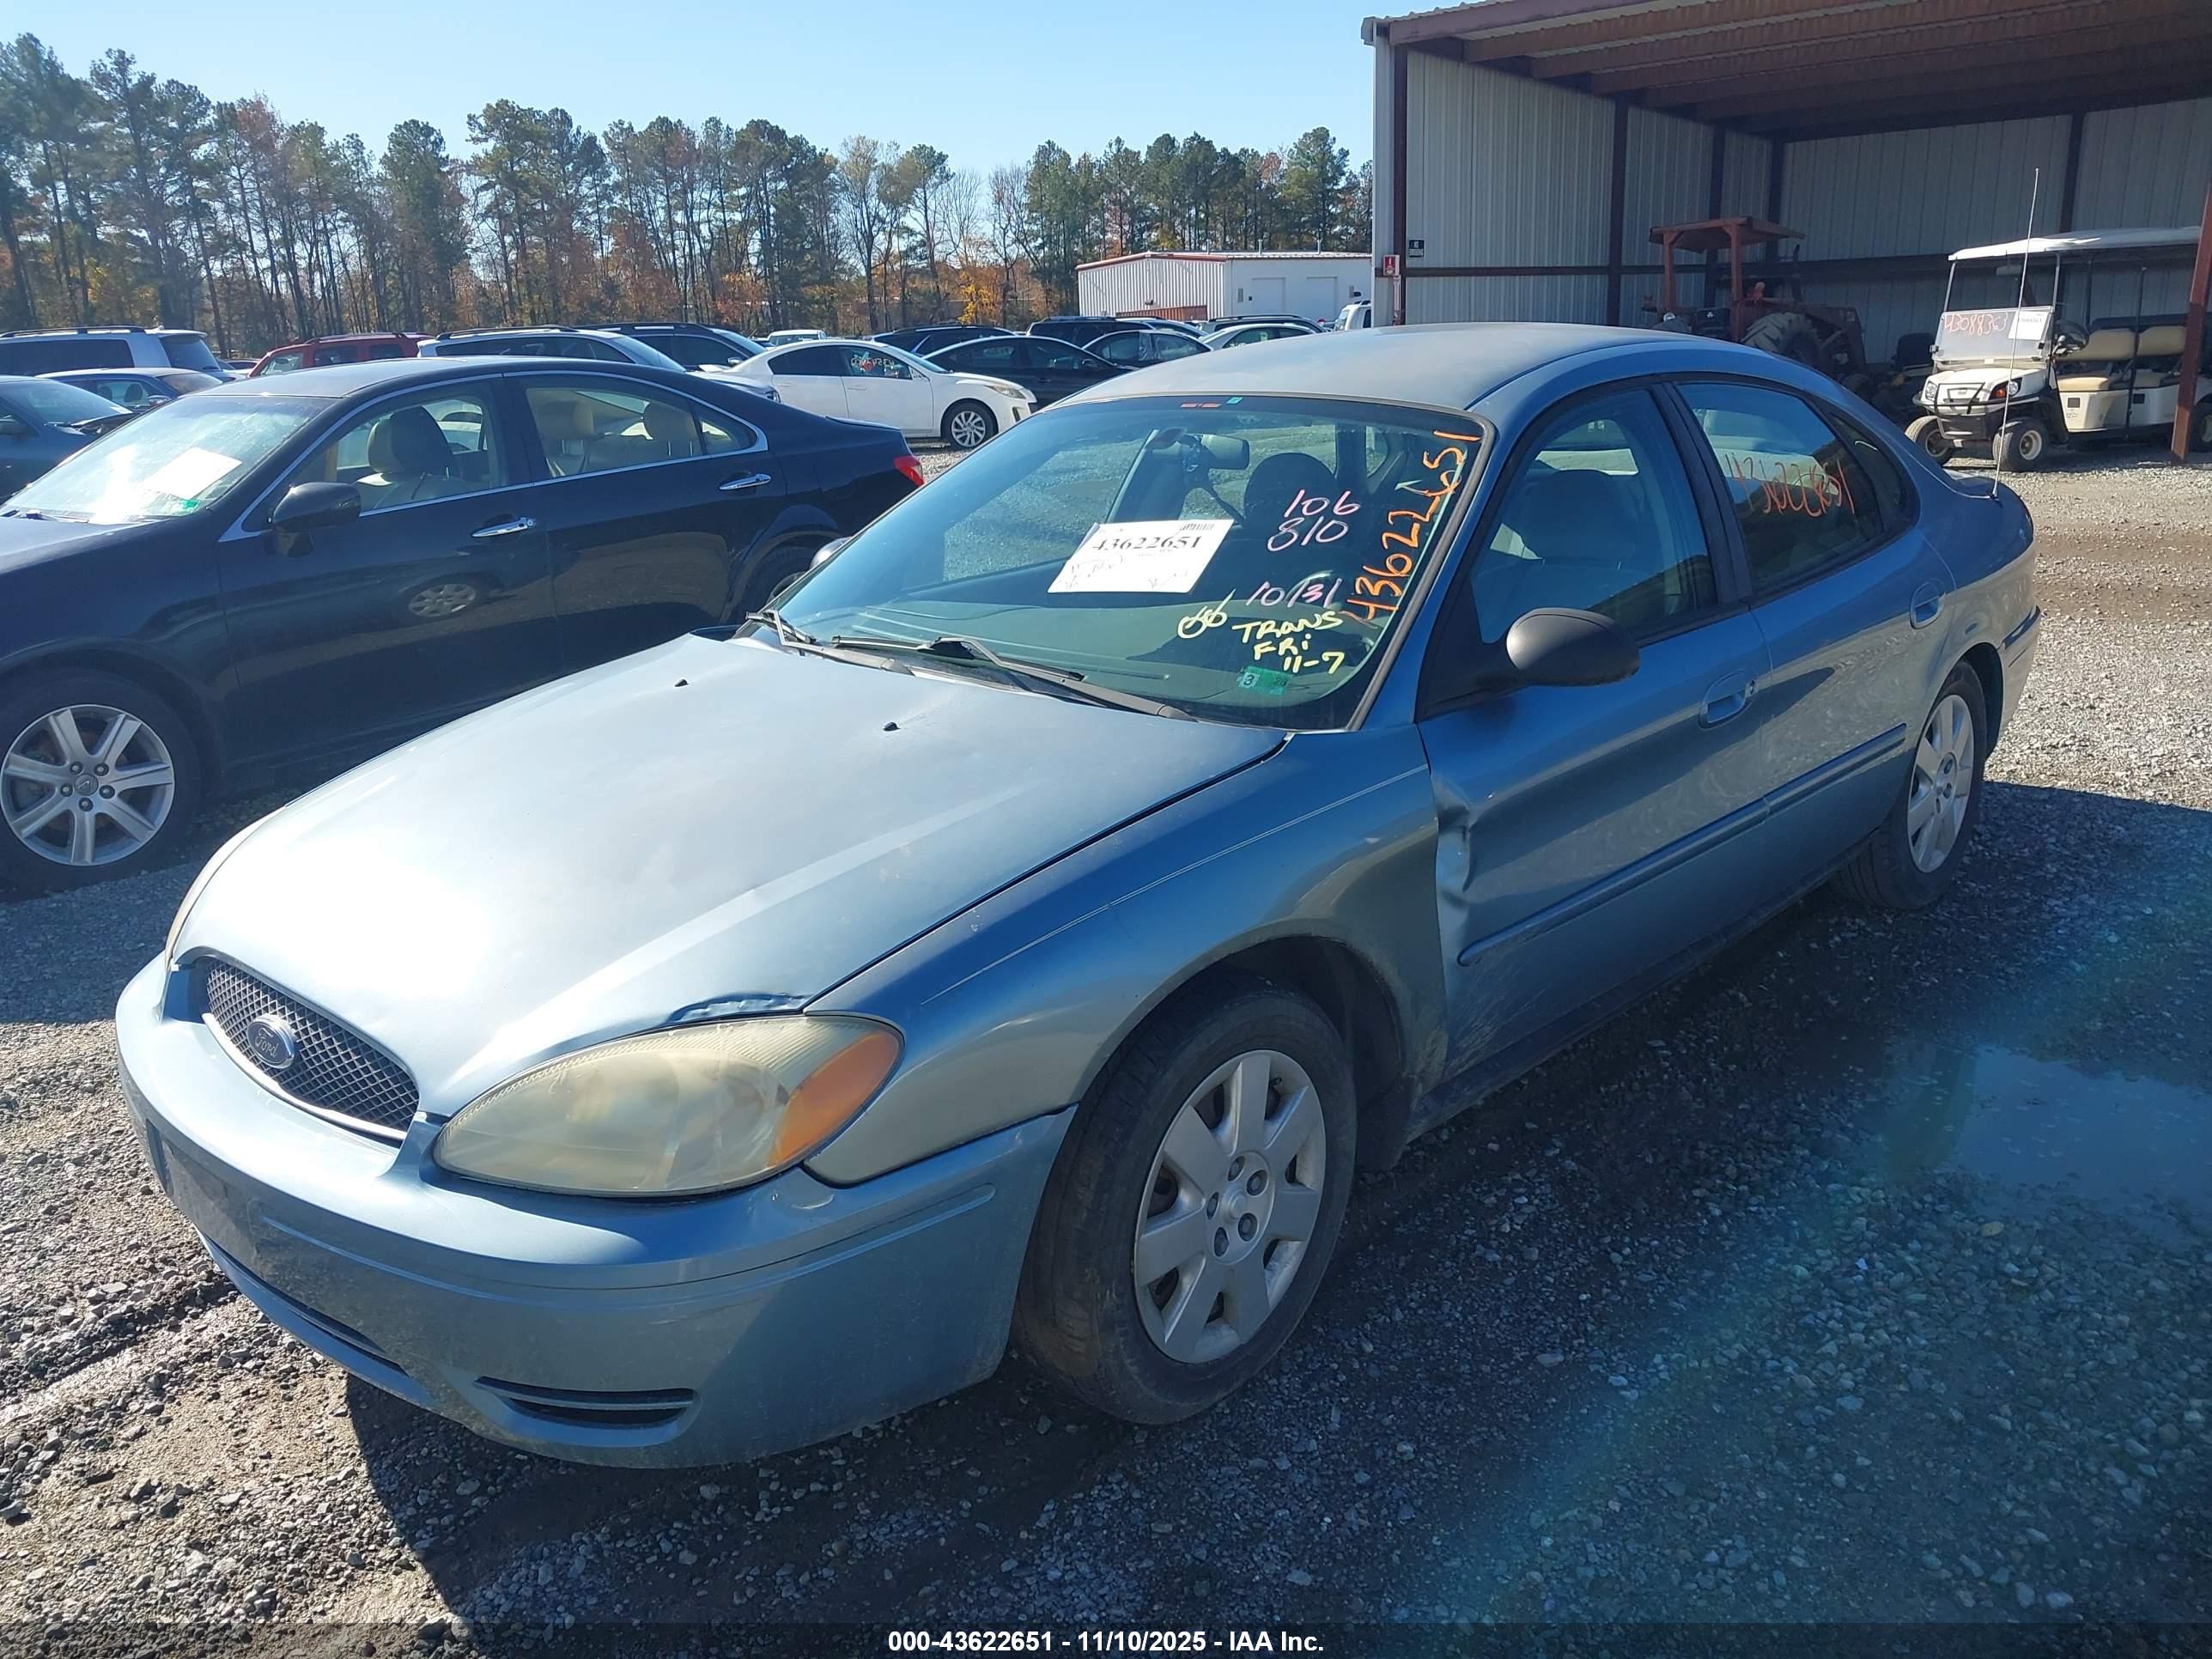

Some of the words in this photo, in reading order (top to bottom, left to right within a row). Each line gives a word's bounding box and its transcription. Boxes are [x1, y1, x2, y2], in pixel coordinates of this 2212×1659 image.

[1284, 489, 1361, 518] 106
[1092, 535, 1203, 551] 43622651
[1267, 515, 1349, 551] 810
[1339, 430, 1481, 629] 43622651
[1245, 576, 1343, 608] 10/31
[1284, 652, 1346, 674] 11-7
[254, 1026, 280, 1058] Ford
